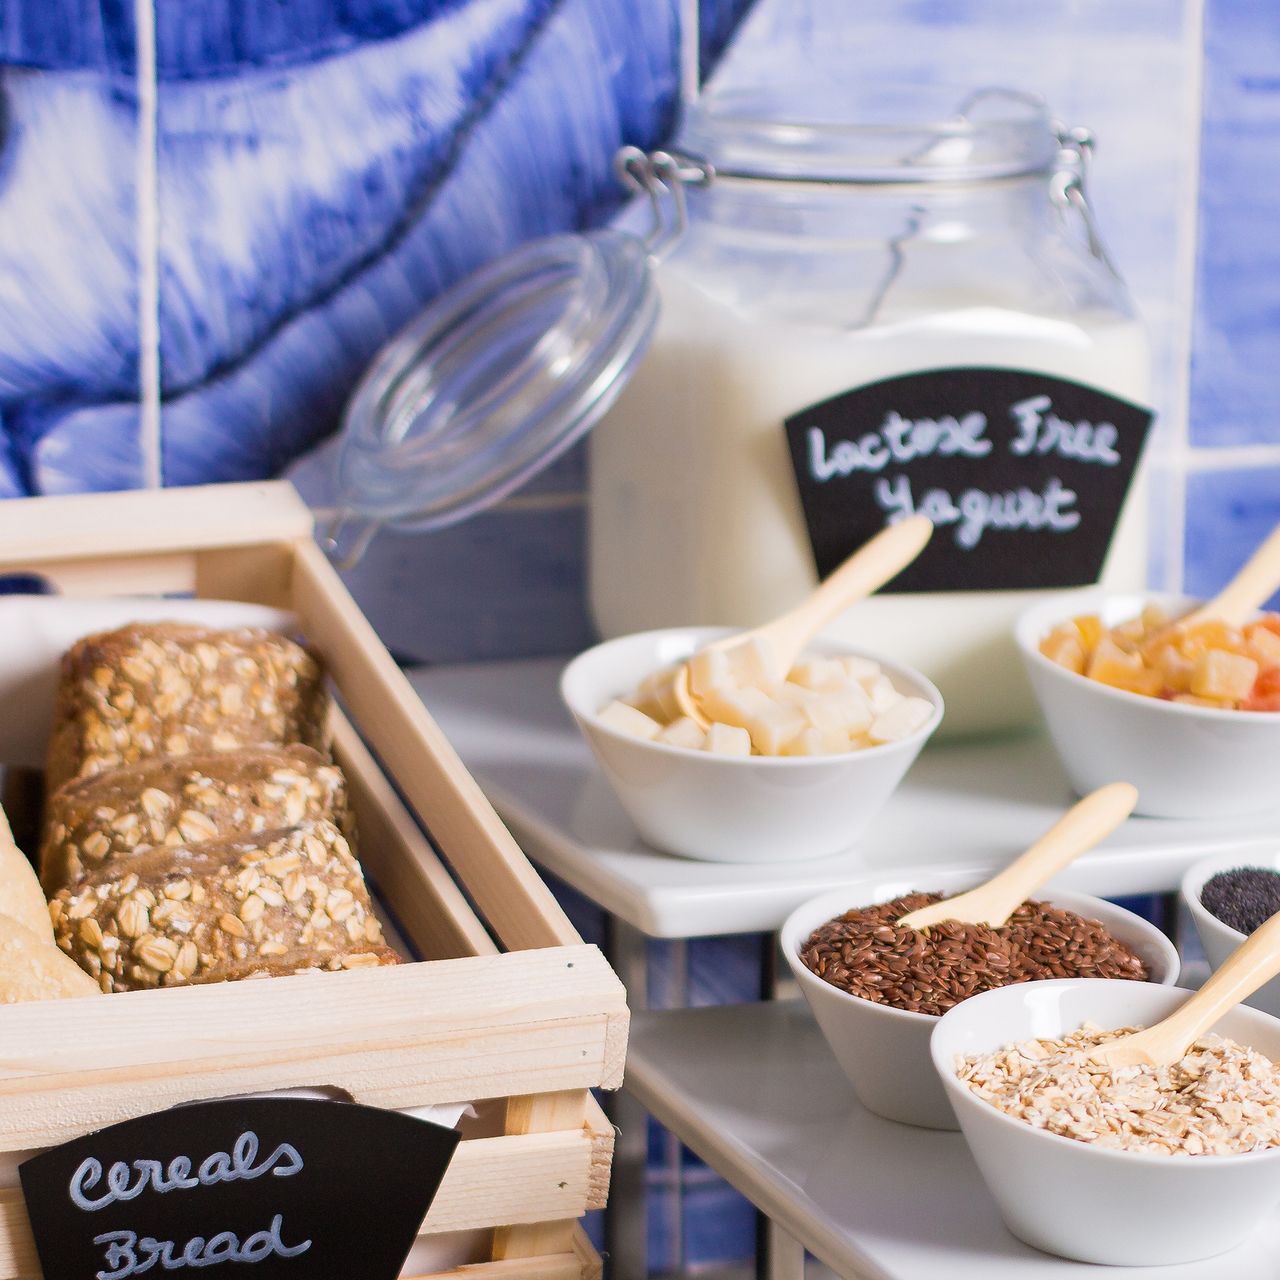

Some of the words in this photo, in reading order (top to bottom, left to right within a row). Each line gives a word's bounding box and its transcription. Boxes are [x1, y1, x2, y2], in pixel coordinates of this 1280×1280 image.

[806, 411, 992, 482] Lactose
[1010, 394, 1121, 467] Free
[69, 1130, 305, 1212] Cereals
